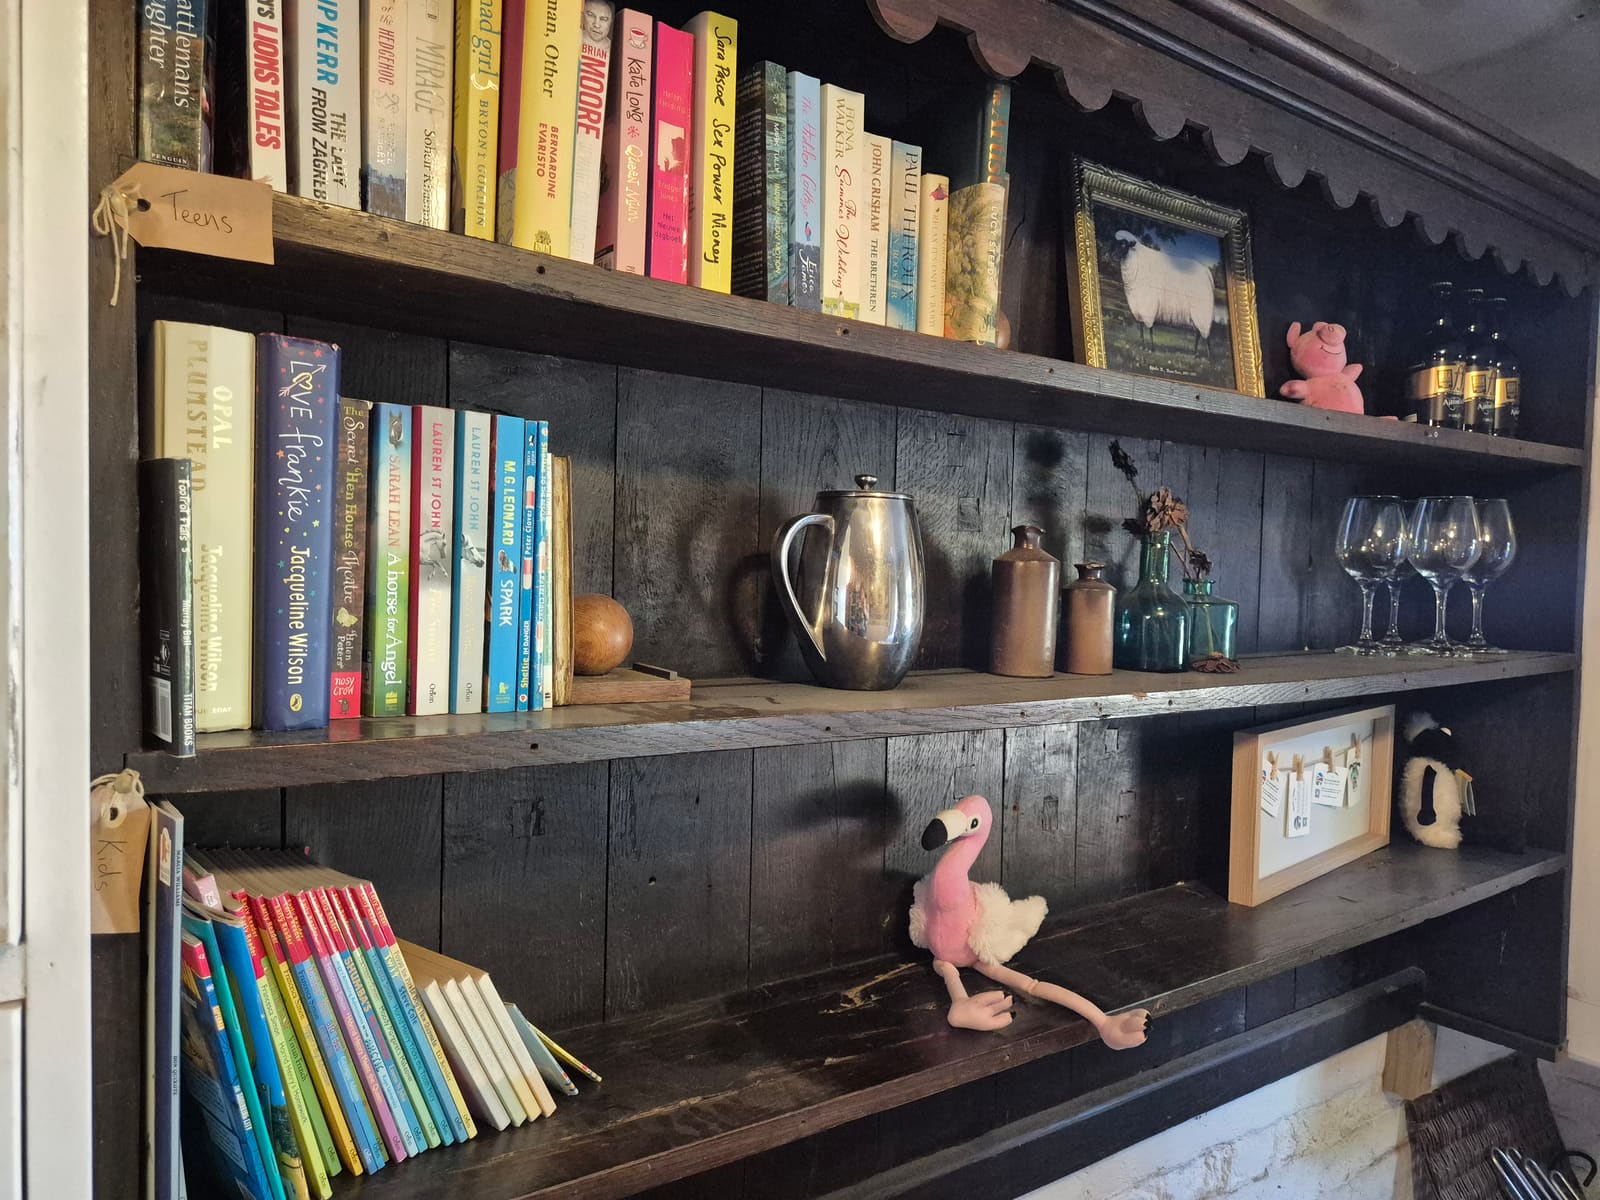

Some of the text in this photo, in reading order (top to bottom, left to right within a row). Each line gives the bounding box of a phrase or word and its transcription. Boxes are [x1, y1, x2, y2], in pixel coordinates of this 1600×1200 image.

[317, 22, 338, 86] KERR
[471, 34, 499, 78] girl
[543, 44, 559, 98] Other
[582, 44, 608, 59] BRIAN
[253, 21, 281, 150] LIONS TALES
[311, 87, 327, 135] FROM
[577, 55, 608, 140] MOORE
[626, 57, 646, 124] Kate Long
[537, 122, 547, 177] EVARISTO
[703, 26, 732, 264] Sara Pascoe Sex Power Money
[835, 98, 846, 159] WALKER
[547, 126, 559, 199] BERNARDINE
[870, 142, 882, 176] JOHN
[904, 151, 918, 199] PAUL
[161, 189, 233, 234] Teens
[870, 177, 881, 232] GRISHAM
[869, 260, 878, 313] BRETHREN
[186, 340, 208, 492] PLUMSTEAD
[212, 385, 233, 449] OPAL
[344, 405, 364, 417] The
[345, 467, 364, 501] Hen
[387, 455, 401, 547] SARAH LEAN
[431, 422, 443, 528] LAUREN ST JOHN
[469, 427, 482, 531] LAUREN ST JOHN
[344, 504, 357, 548] House
[502, 488, 515, 546] LEONARD
[524, 510, 534, 555] Peter Clover
[388, 552, 402, 566] A
[283, 545, 310, 685] Jacqueline Wilson
[386, 571, 404, 615] horse
[498, 579, 514, 627] SPARK
[336, 635, 346, 669] Peters
[346, 630, 358, 661] Helen
[386, 618, 398, 634] for
[381, 634, 402, 685] Angel
[184, 693, 194, 746] TITAN BOOKS
[95, 839, 128, 892] Kids
[175, 849, 183, 874] MARCIA
[174, 876, 182, 907] WILLIAMS
[342, 954, 373, 1013] SHUMBA'S
[396, 983, 420, 1025] Steve Cole
